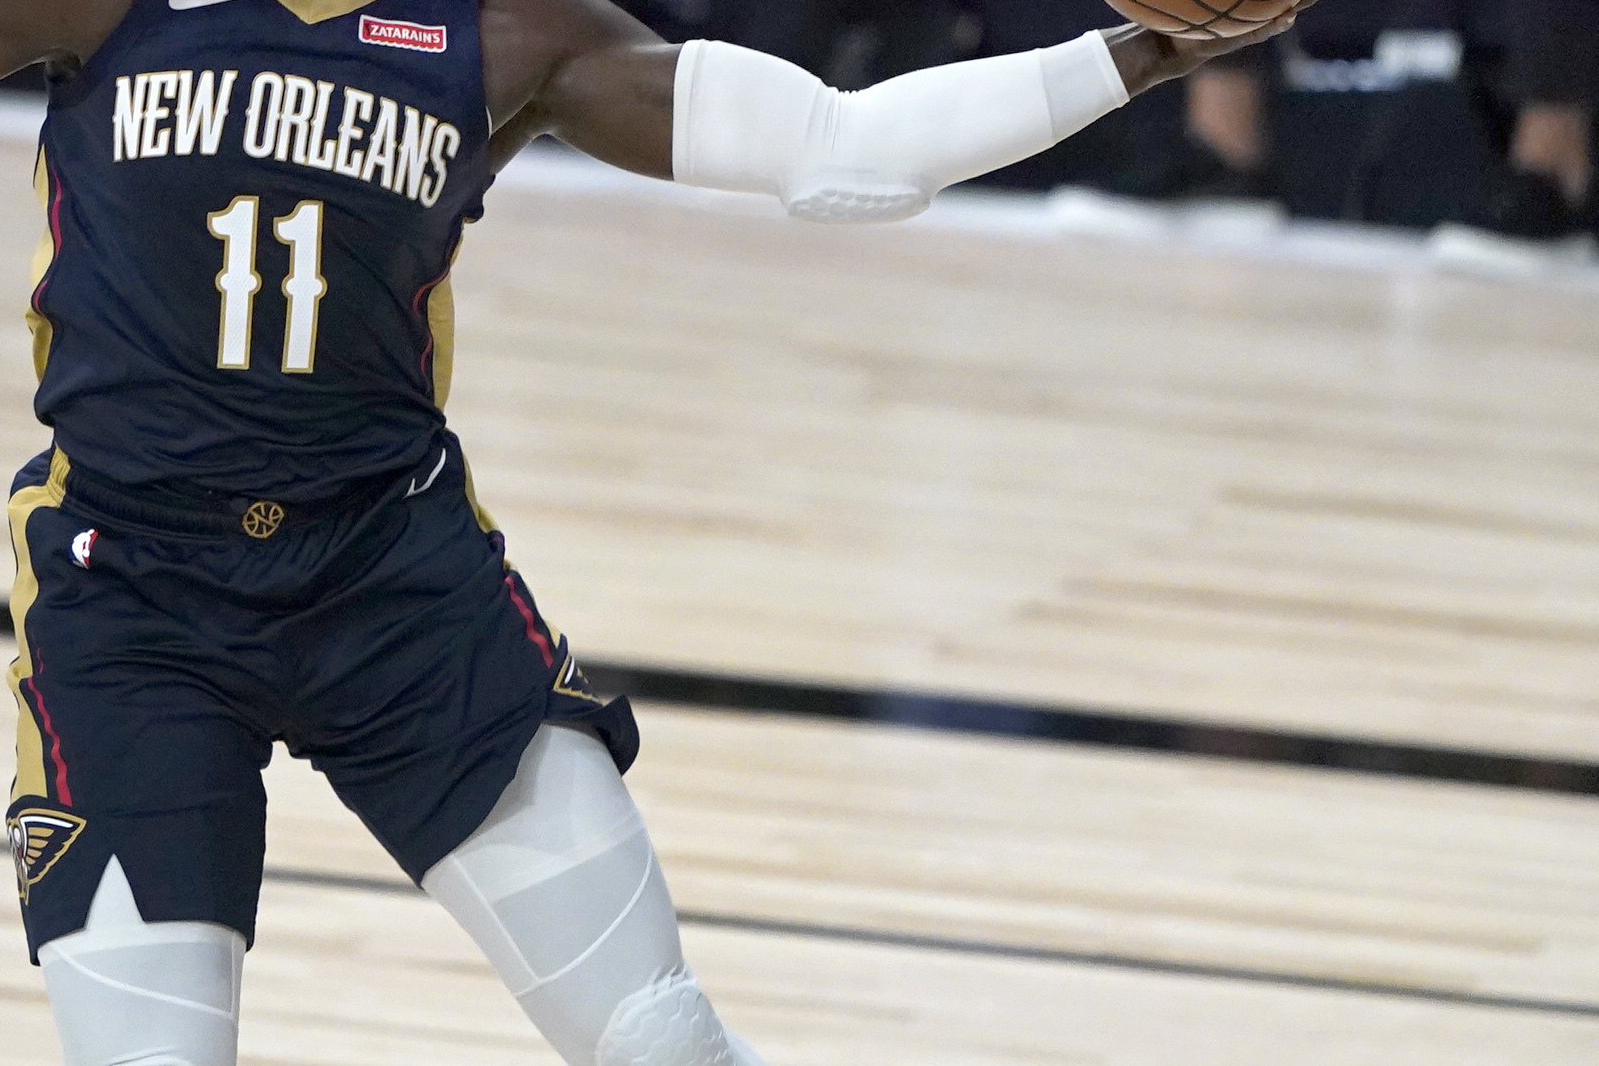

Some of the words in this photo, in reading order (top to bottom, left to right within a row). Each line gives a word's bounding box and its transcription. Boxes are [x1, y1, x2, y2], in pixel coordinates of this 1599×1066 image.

[370, 25, 441, 44] ZATARAIN'S
[112, 70, 239, 163] NEW
[243, 71, 461, 209] ORLEANS
[207, 195, 327, 374] 11
